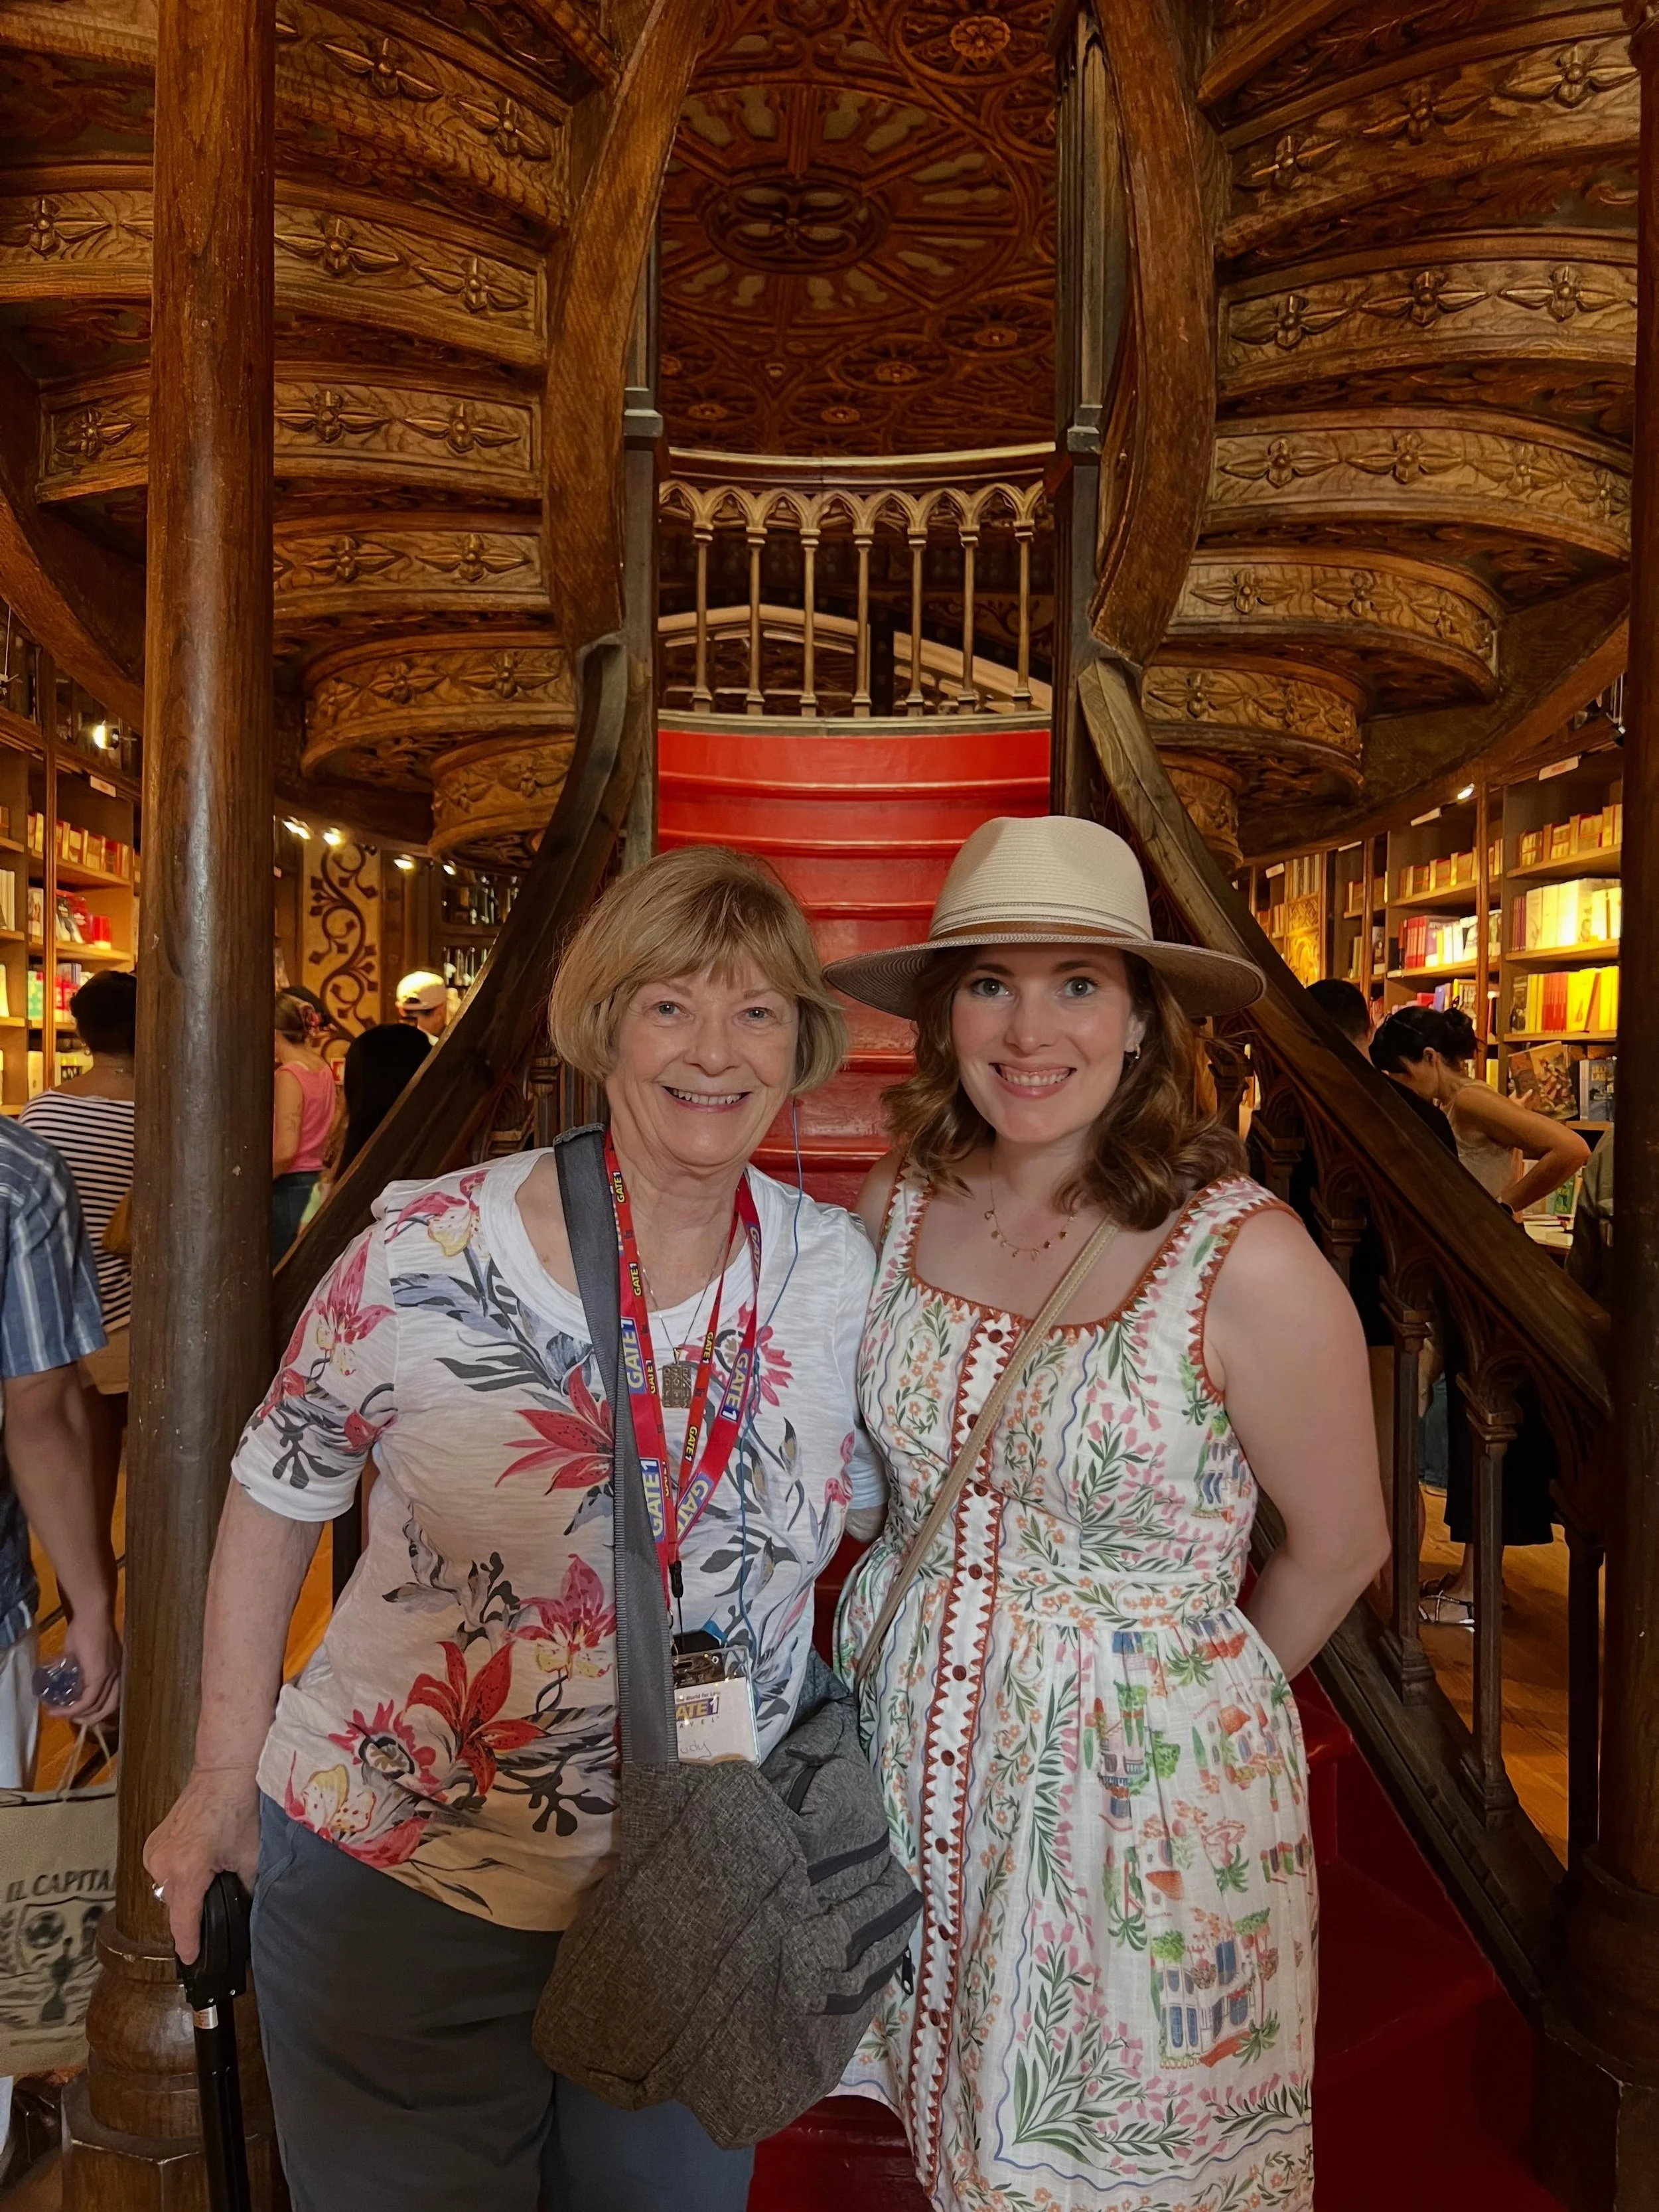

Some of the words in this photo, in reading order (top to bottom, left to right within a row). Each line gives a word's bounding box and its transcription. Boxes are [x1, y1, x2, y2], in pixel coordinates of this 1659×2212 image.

[676, 1696, 717, 1720] ATE1
[679, 1717, 715, 1729] AVEL
[680, 1738, 712, 1760] udy
